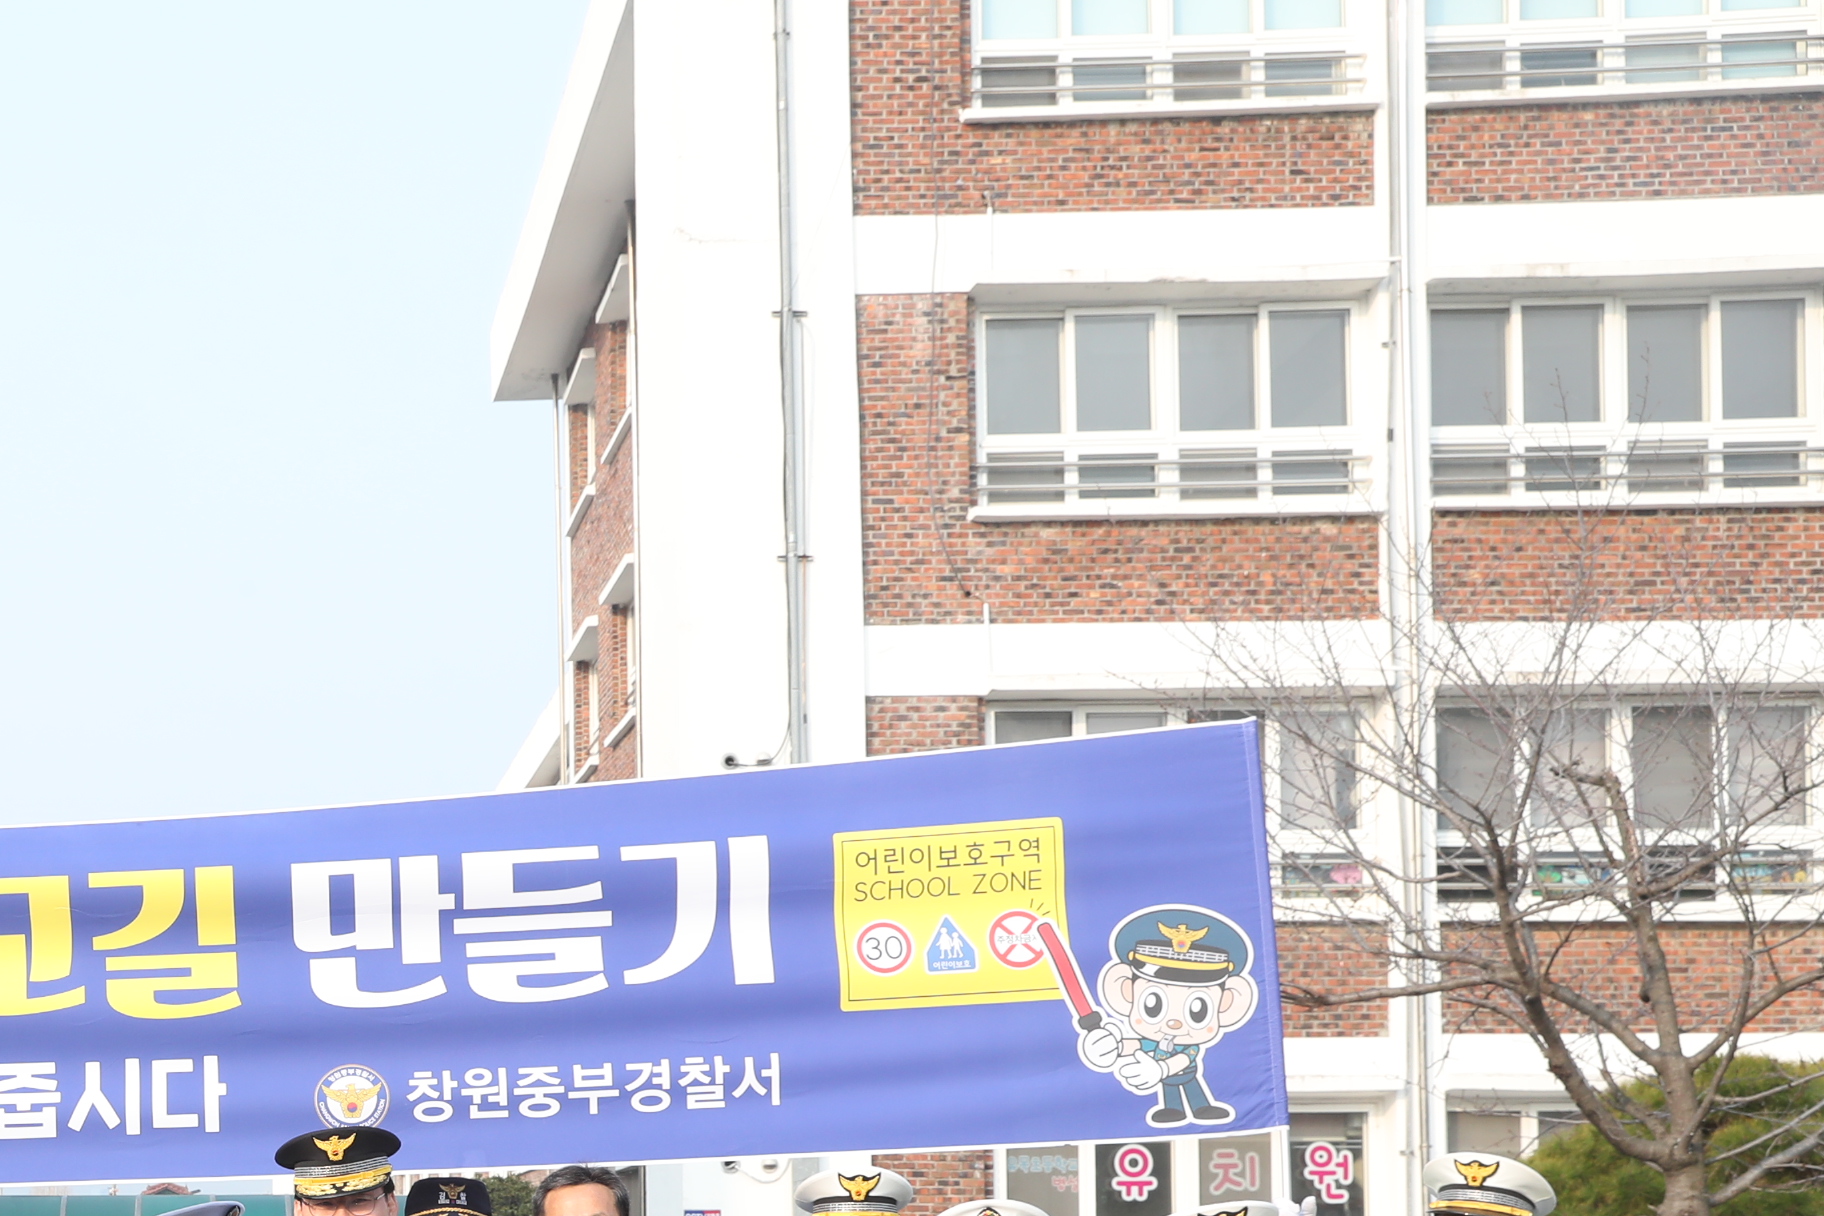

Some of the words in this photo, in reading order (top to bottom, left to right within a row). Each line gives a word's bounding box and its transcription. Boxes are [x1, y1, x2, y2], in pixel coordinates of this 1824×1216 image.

[855, 837, 1041, 876] 어린이보호구역
[854, 876, 961, 902] SCHOOL
[972, 870, 1042, 895] ZONE
[291, 833, 775, 1009] 만들기
[865, 936, 903, 961] 30
[933, 960, 972, 970] 어린이보호
[405, 1052, 781, 1123] 창원중부경찰서
